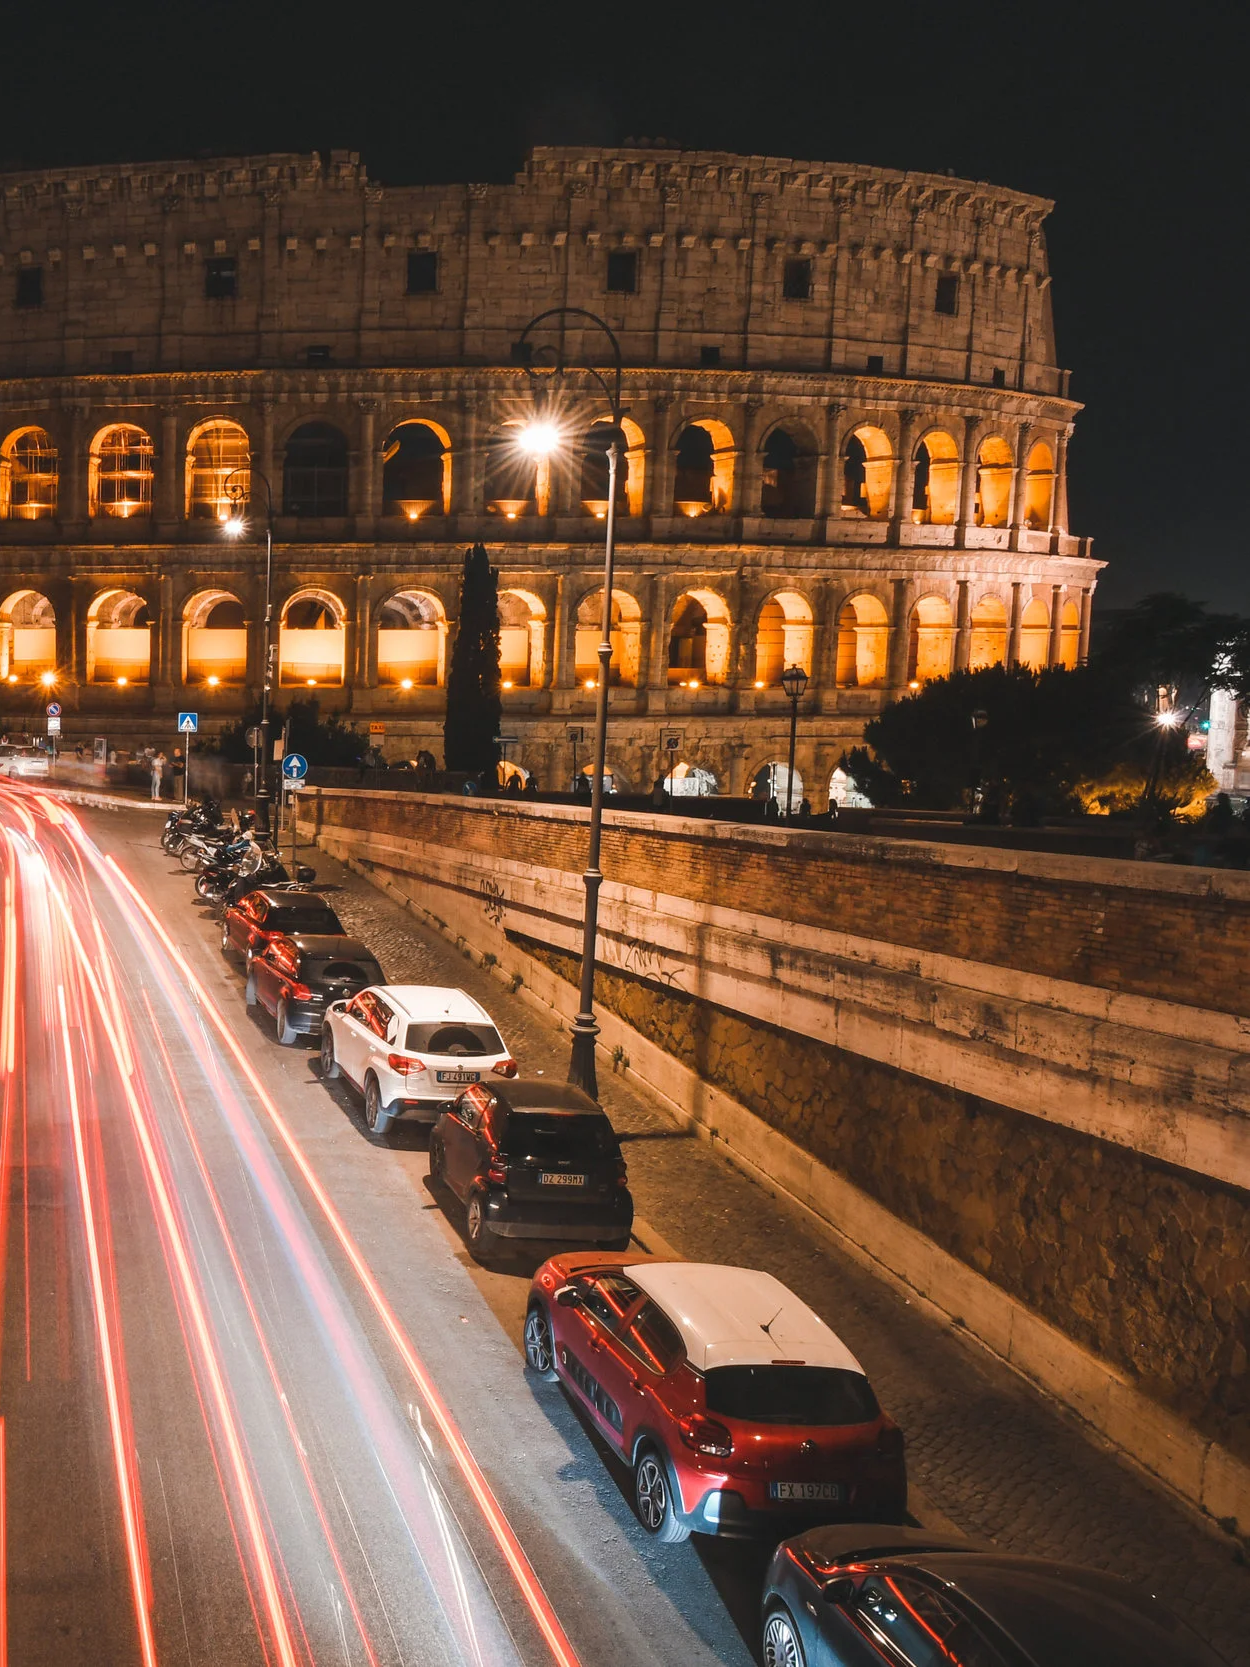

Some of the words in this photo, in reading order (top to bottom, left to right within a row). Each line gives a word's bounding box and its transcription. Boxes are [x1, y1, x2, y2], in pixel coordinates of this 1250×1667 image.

[442, 1072, 451, 1080] FJ
[543, 1174, 554, 1183] DZ
[557, 1175, 583, 1184] 299MX
[779, 1483, 795, 1497] FX
